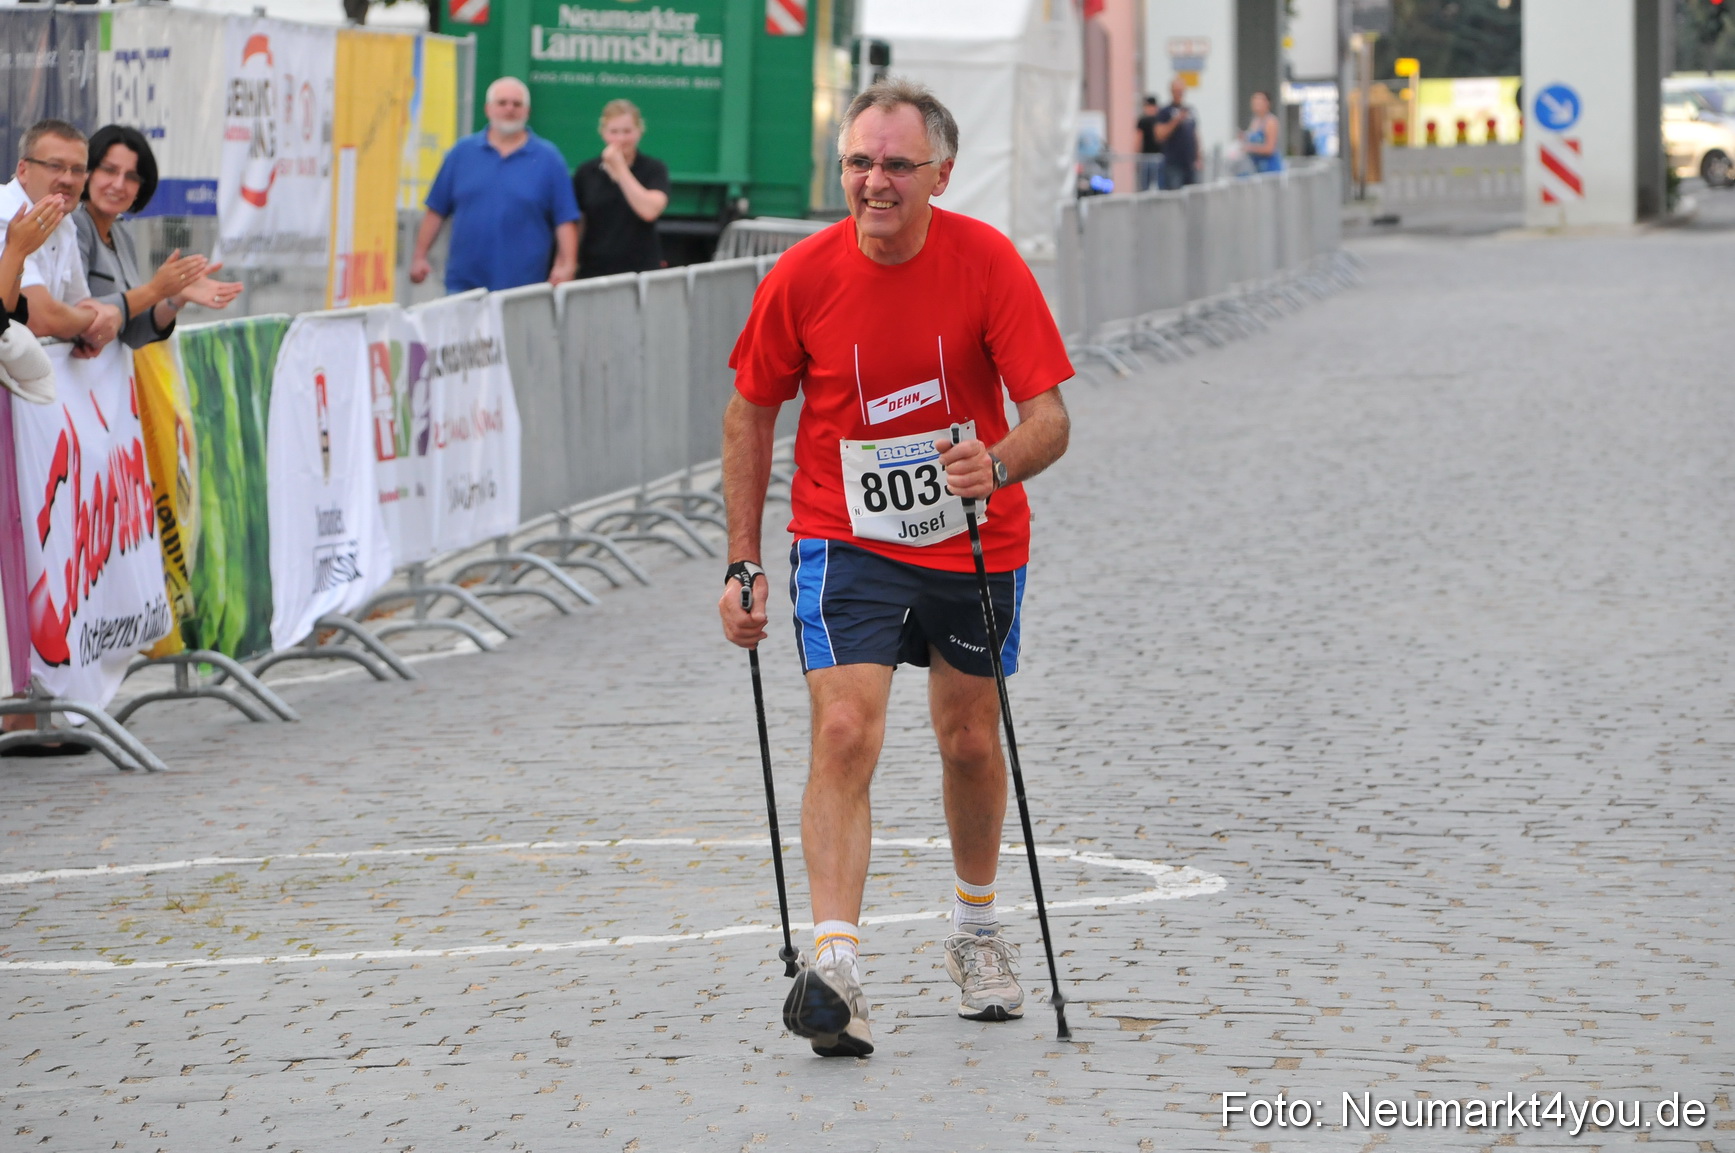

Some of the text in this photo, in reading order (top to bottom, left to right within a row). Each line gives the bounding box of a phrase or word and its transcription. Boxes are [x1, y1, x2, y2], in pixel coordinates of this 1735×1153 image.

[559, 4, 698, 31] Neumarkter
[531, 25, 722, 67] Lammsbräu
[888, 391, 921, 413] DEHN
[877, 440, 935, 461] BOCK
[860, 464, 955, 513] 803
[898, 510, 946, 539] Josef
[957, 639, 986, 653] LIMIT
